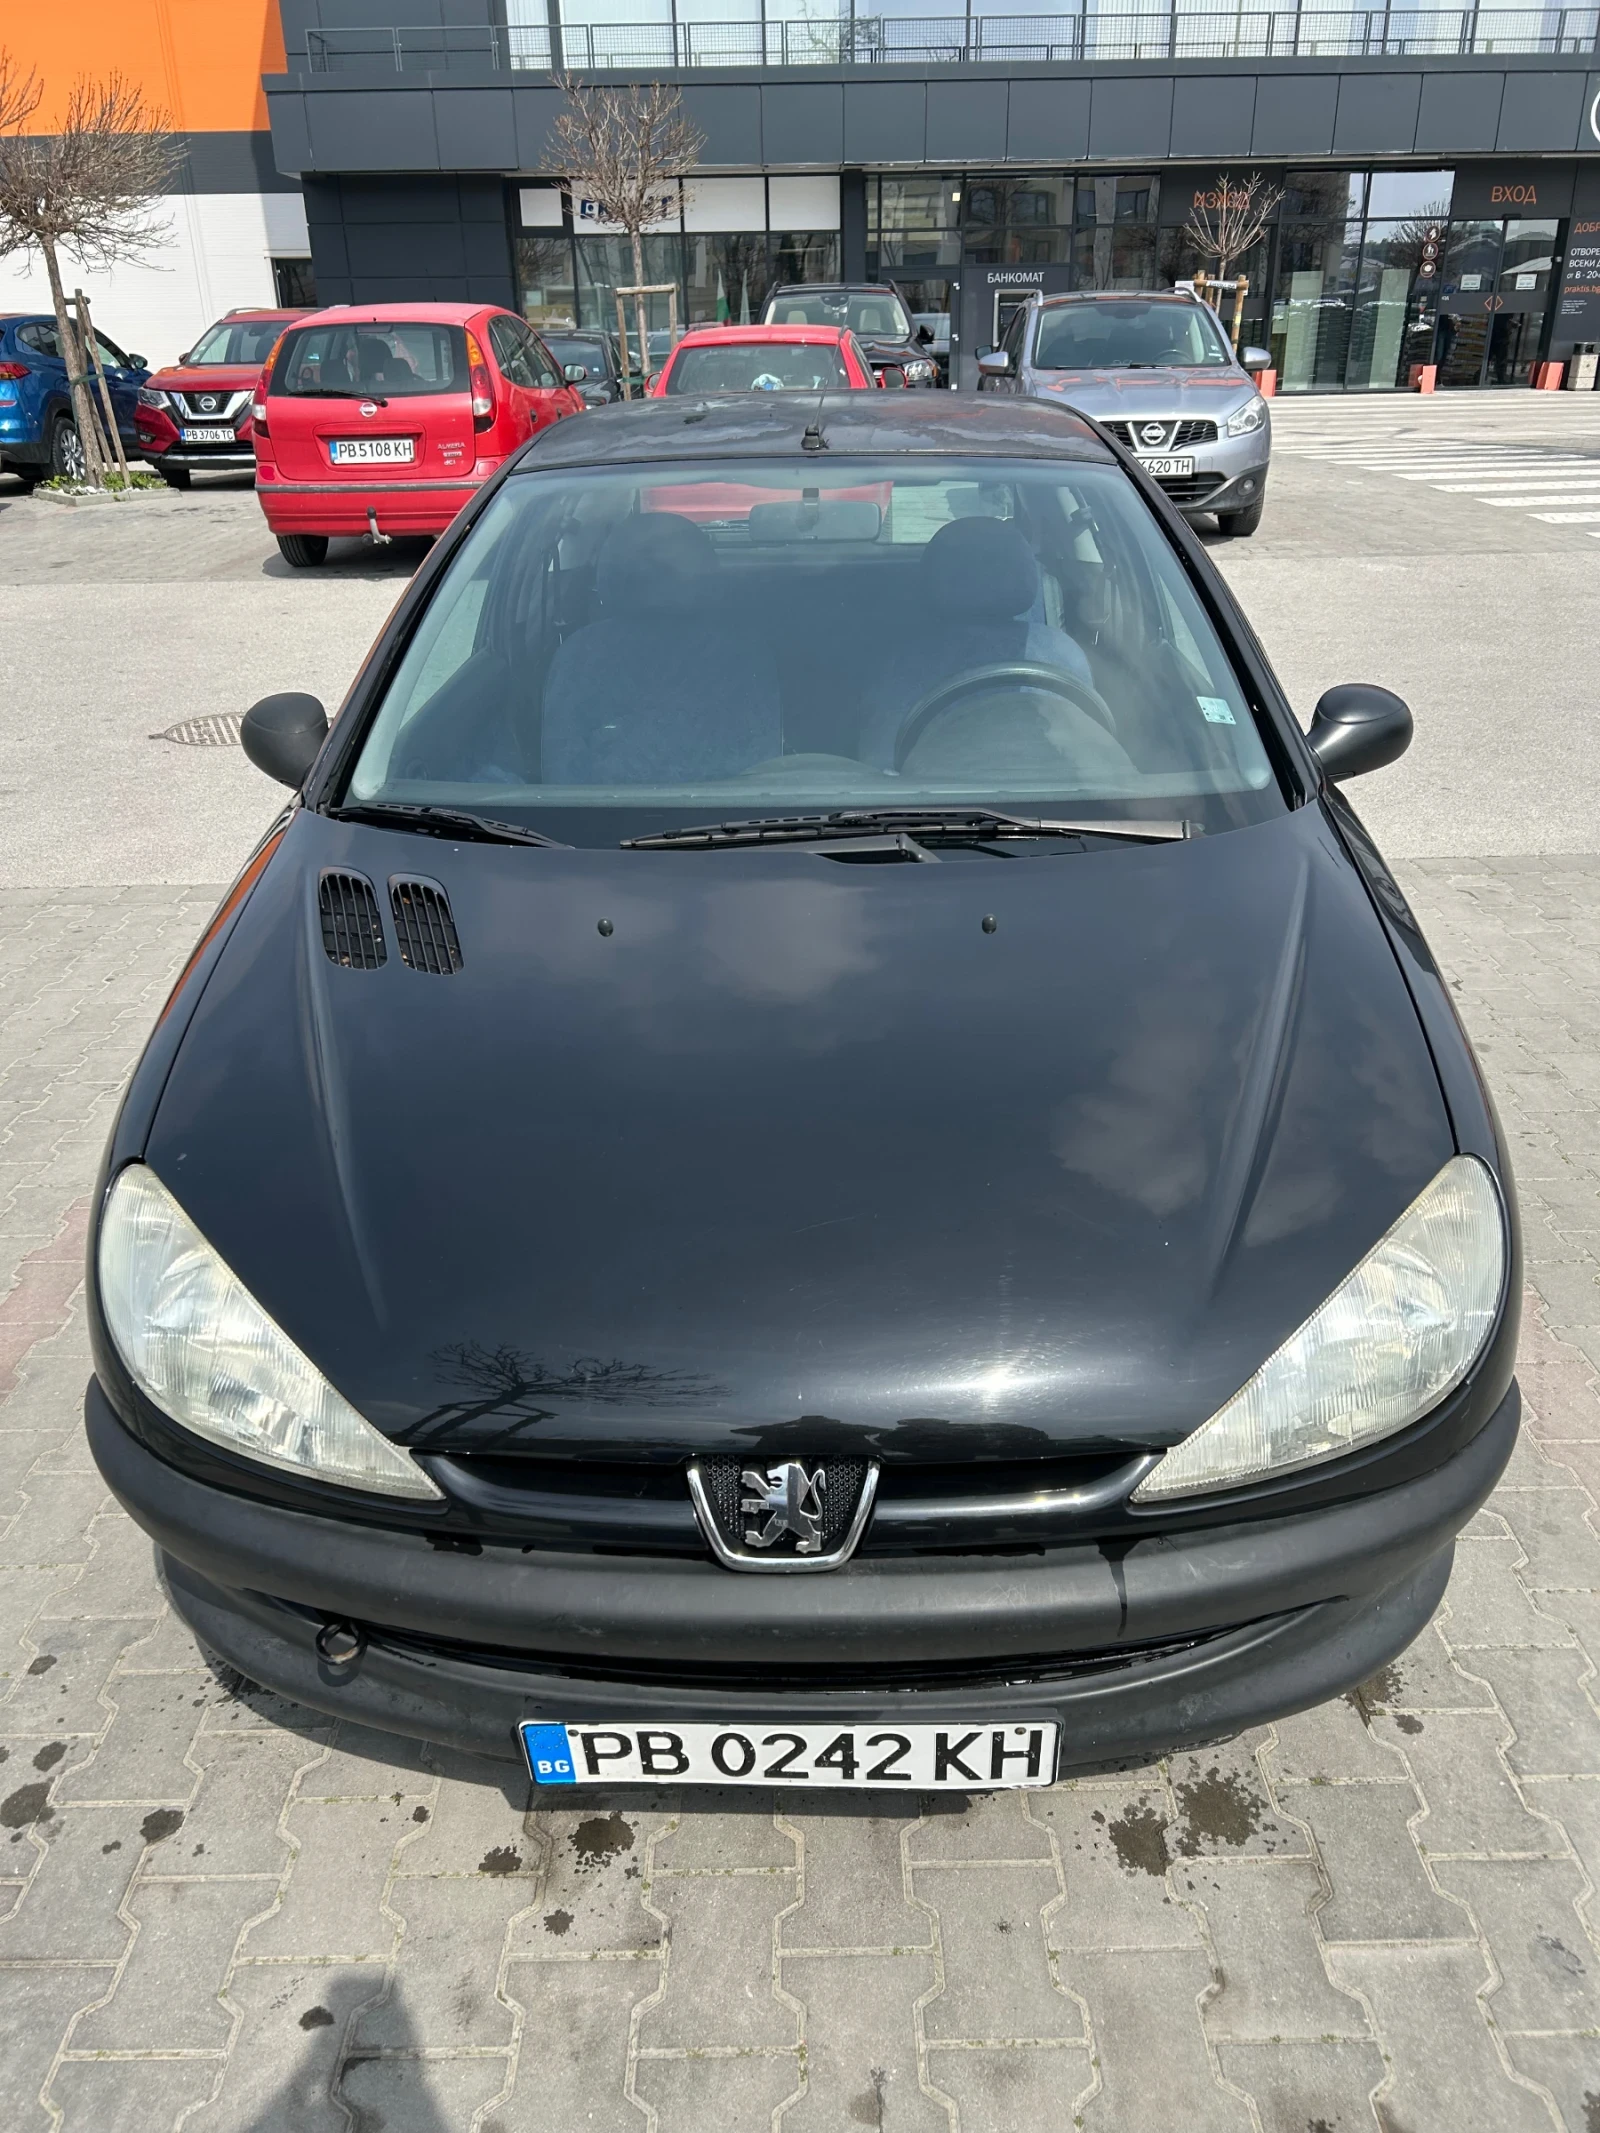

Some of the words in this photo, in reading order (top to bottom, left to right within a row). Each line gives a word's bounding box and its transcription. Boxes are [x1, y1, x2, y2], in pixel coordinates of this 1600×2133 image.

[1491, 185, 1537, 204] ВХОД
[1568, 259, 1595, 268] ВСЕКИ
[987, 271, 1045, 284] БАНКОМАТ
[186, 430, 198, 440] PB
[199, 430, 220, 440] 3706
[221, 430, 233, 440] TC
[338, 443, 357, 458] PB
[358, 442, 392, 458] 5108
[394, 442, 412, 456] KH
[1173, 460, 1190, 473] TH
[580, 1730, 690, 1776] PB
[711, 1732, 912, 1780] 0242
[933, 1729, 1042, 1780] KH
[537, 1759, 571, 1775] BG
